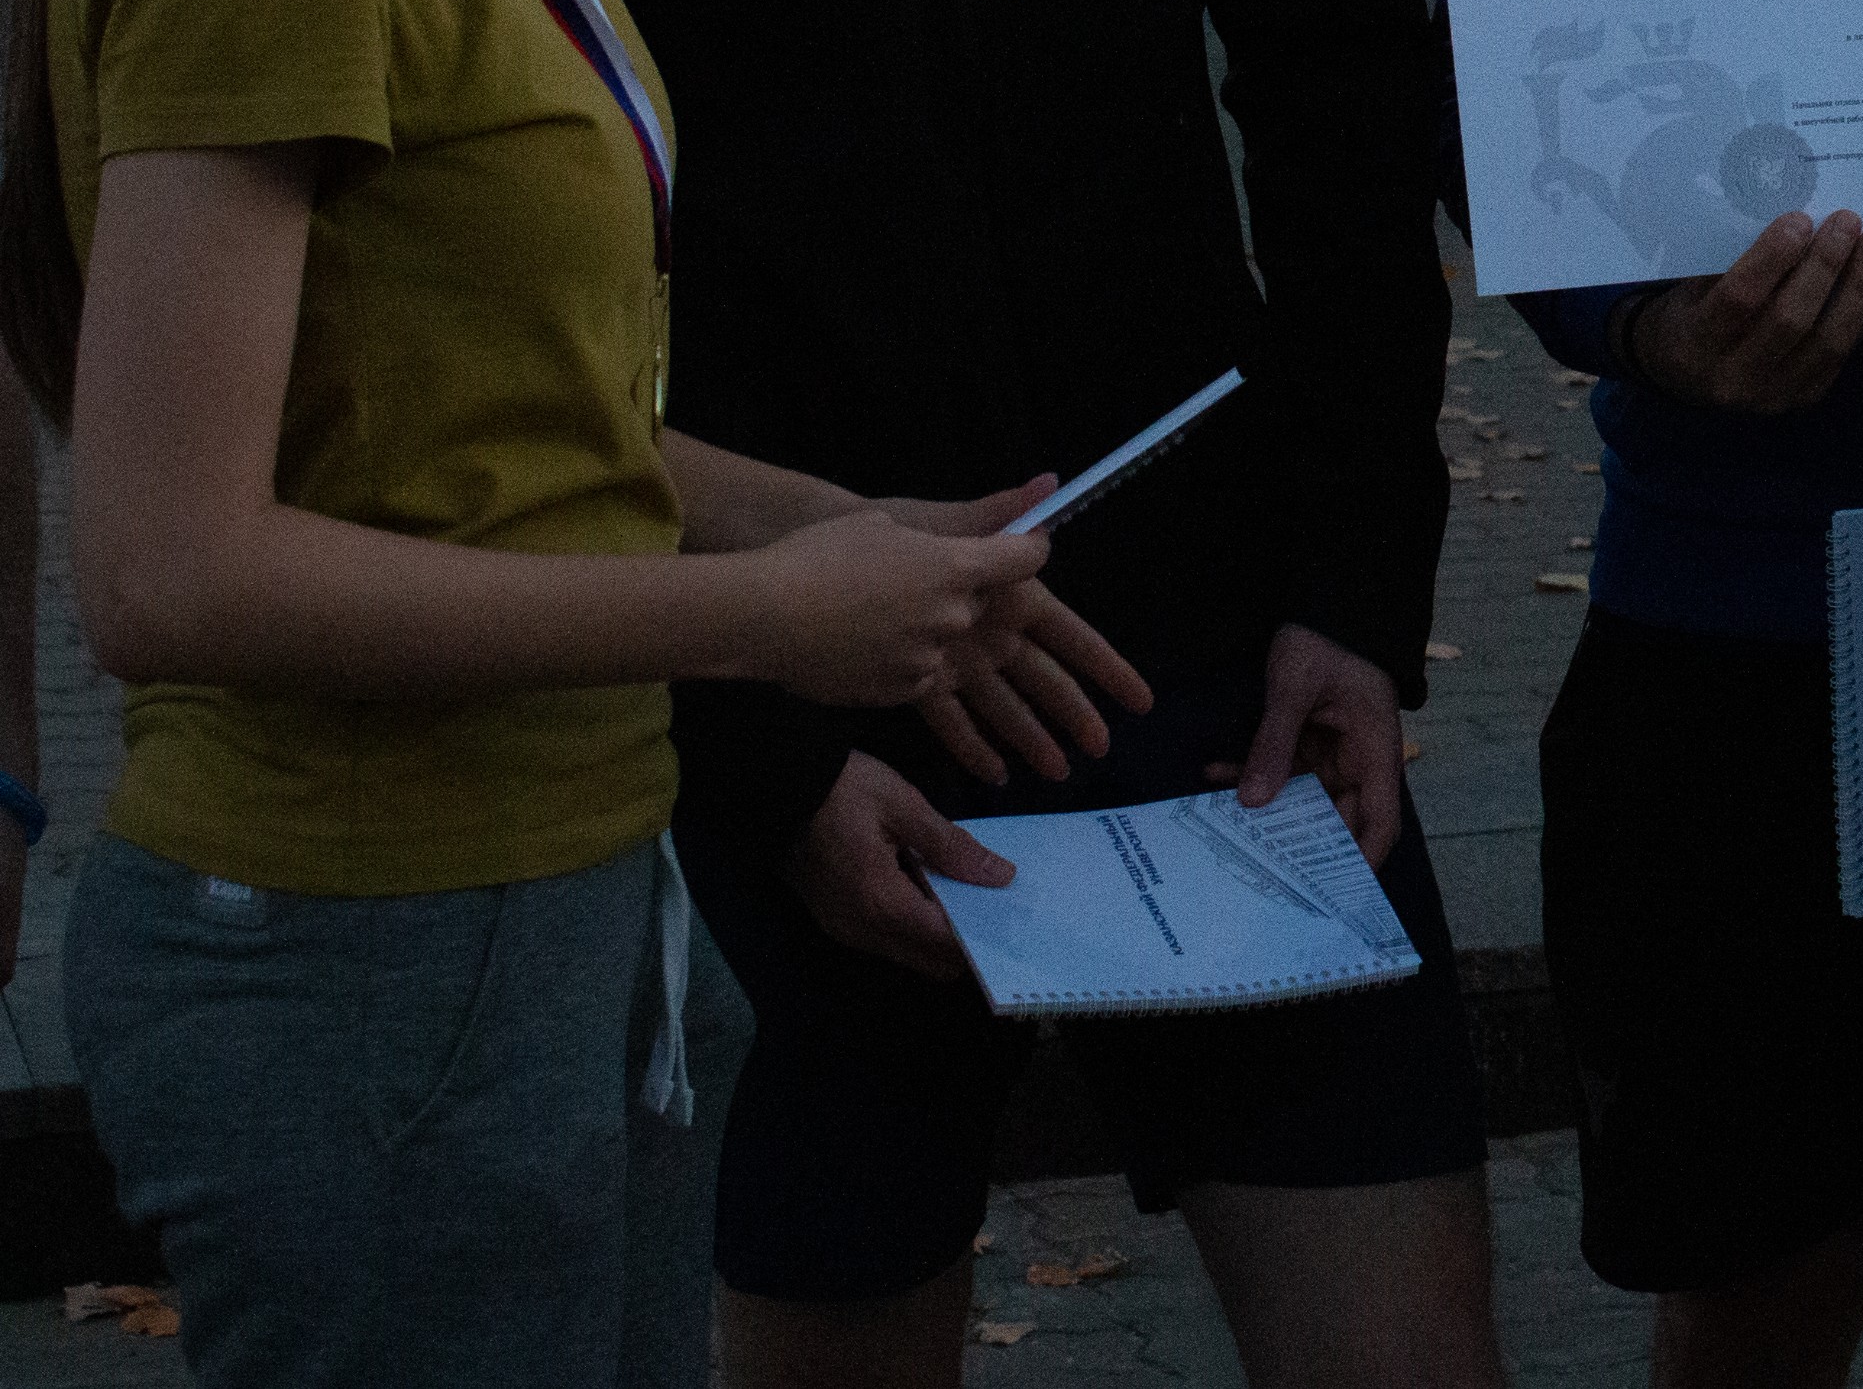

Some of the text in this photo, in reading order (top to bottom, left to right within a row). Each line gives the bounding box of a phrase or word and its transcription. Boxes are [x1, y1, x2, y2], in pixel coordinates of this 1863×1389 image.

[1097, 814, 1184, 956] КАЗАНСКИЙ ФЕДЕРАЛЬНЫЙ
[1116, 813, 1164, 886] УНИВЕРСИТЕТ
